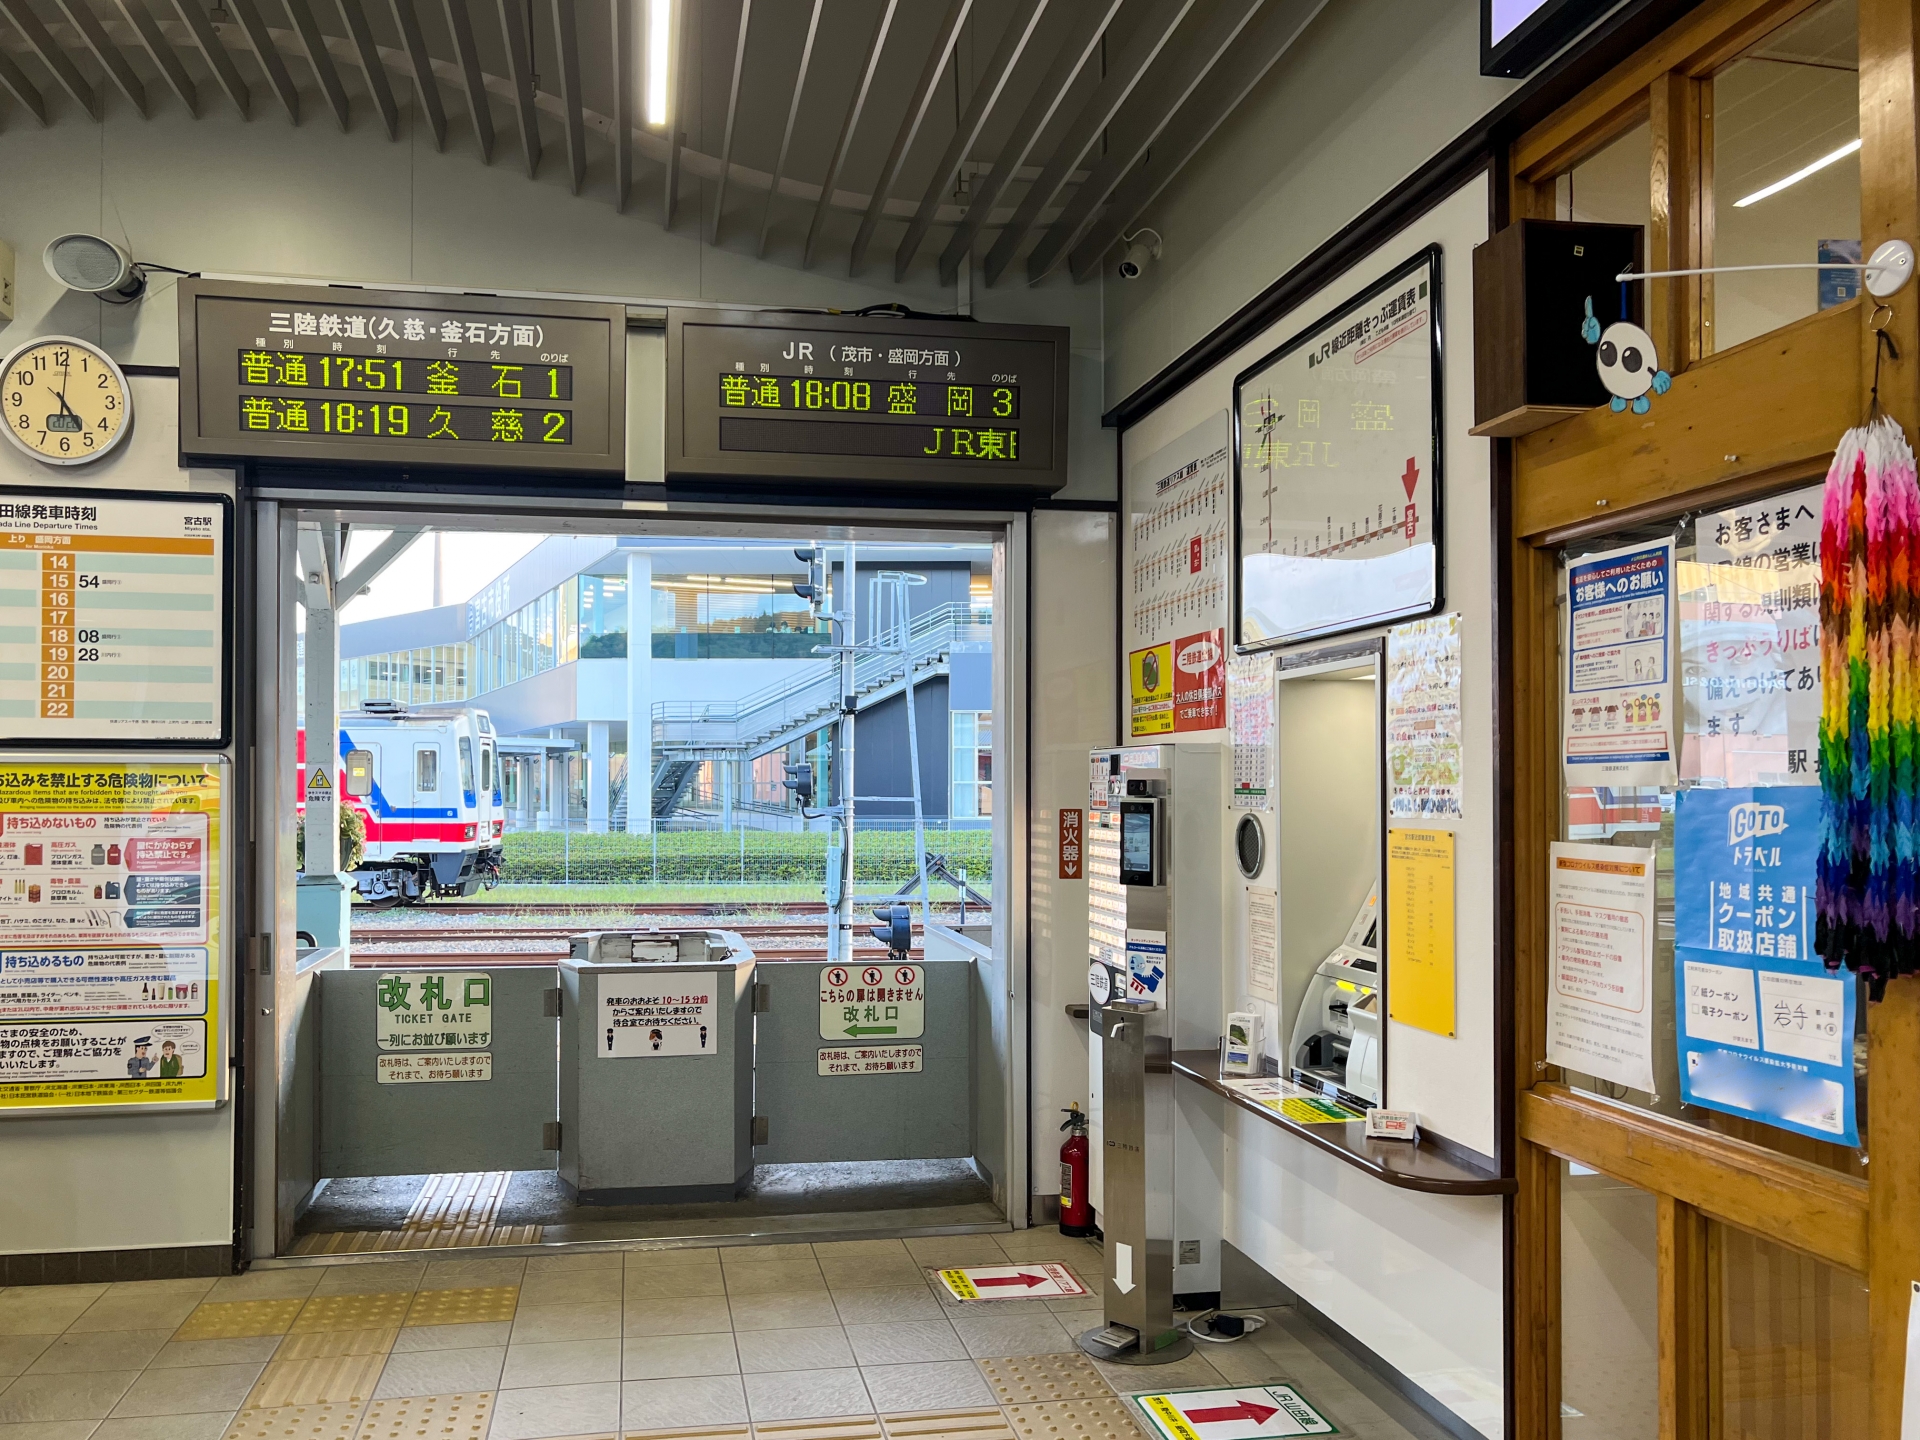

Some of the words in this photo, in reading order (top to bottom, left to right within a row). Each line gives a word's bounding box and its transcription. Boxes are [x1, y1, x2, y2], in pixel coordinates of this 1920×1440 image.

[540, 352, 569, 364] のりば
[782, 342, 814, 361] JR
[32, 355, 46, 370] 11
[52, 351, 70, 367] 12
[80, 358, 87, 372] 1
[16, 371, 34, 386] 10
[97, 373, 109, 388] 2
[241, 351, 308, 386] 普通
[319, 357, 403, 391] 17:51
[426, 361, 522, 399] 釜石
[547, 368, 558, 398] 1
[991, 373, 1017, 384] のりば
[11, 392, 22, 407] 9
[105, 395, 115, 410] 3
[721, 375, 780, 408] 普通
[790, 379, 870, 411] 18:08
[887, 383, 973, 417] 盛岡
[992, 388, 1012, 417] 3
[19, 414, 30, 429] 8
[97, 417, 109, 431] 4
[242, 397, 309, 432] 普通
[320, 402, 409, 435] 18:19
[427, 406, 523, 442] 久慈
[543, 412, 565, 443] 2
[36, 430, 47, 445] 7
[59, 437, 70, 452] 6
[83, 432, 94, 447] 5
[33, 522, 72, 530] Departure
[183, 516, 212, 526] 宮古駅
[1715, 505, 1815, 546] お客さまへ
[8, 534, 26, 543] 上り
[35, 535, 71, 544] 盛岡方面
[50, 555, 68, 569] 14
[50, 574, 68, 587] 15
[78, 575, 99, 588] 54
[1576, 571, 1664, 602] お客様へのお願い
[50, 592, 68, 606] 16
[50, 611, 68, 624] 17
[49, 629, 68, 643] 18
[78, 629, 99, 643] 08
[49, 647, 68, 661] 19
[78, 648, 99, 661] 28
[47, 666, 68, 680] 20
[47, 684, 66, 698] 21
[47, 703, 68, 716] 22
[1707, 713, 1758, 737] ます。
[6, 816, 96, 830] 持ち込めないもの
[1062, 811, 1079, 861] 消火器
[136, 841, 194, 850] 量にかかわらず
[136, 851, 191, 859] 持込禁止です。
[1733, 846, 1782, 867] トラベル
[1559, 860, 1641, 874] 新型コロナウイルス感染症対策について
[1718, 881, 1797, 904] 地域共通
[1718, 903, 1796, 929] クーポン
[1718, 928, 1797, 960] 取扱店舗
[5, 955, 84, 969] 持ち込めるもの
[378, 976, 490, 1012] 改札口
[606, 997, 660, 1006] 発車のおおよそ
[692, 995, 709, 1004] 分前
[820, 987, 923, 1003] こちらの扉は開きません
[1701, 987, 1738, 1002] 紙クーポン
[395, 1013, 433, 1024] TICKET
[442, 1013, 472, 1023] GATE
[612, 1006, 702, 1017] からご案内いたしますので
[843, 1005, 898, 1023] 改札口
[1701, 1005, 1748, 1022] 電子クーポン
[1774, 1000, 1808, 1030] 岩手
[613, 1017, 700, 1027] 待合室でお待ちください。
[0, 1028, 82, 1038] さまの安全のため、
[378, 1031, 490, 1047] 一列にお並び願います
[0, 1036, 127, 1049] 物の点検をお願いすることが
[820, 1048, 921, 1061] 改札時は、ご案内いたしますので
[0, 1060, 60, 1069] いいたします。
[379, 1056, 491, 1068] 改札時は、ご案内いたしますので
[828, 1061, 915, 1073] それまで、お待ち願います
[388, 1069, 483, 1080] それまで、お待ち願います
[1272, 1391, 1319, 1425] JR山田線
